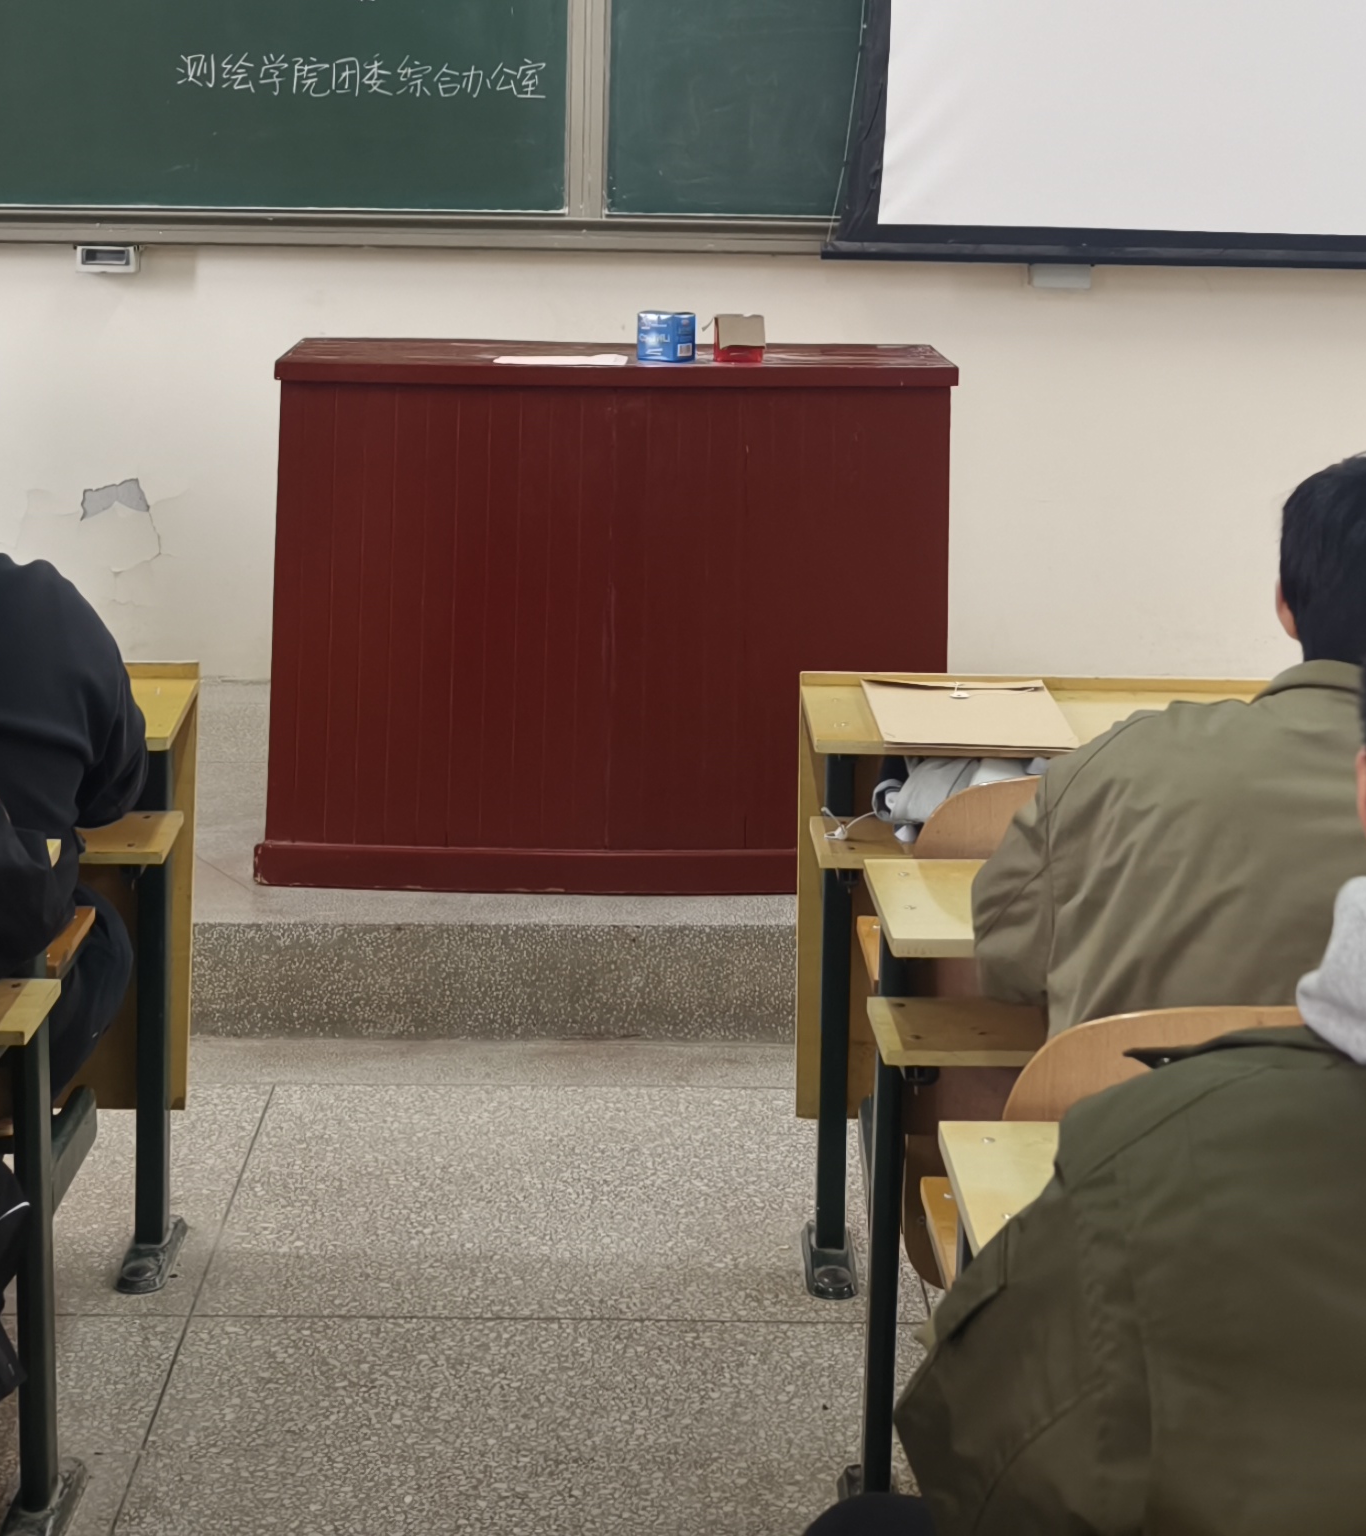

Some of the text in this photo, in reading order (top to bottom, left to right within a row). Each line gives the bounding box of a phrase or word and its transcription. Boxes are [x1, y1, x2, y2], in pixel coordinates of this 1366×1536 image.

[176, 52, 547, 99] 测绘学院团委综合办公室
